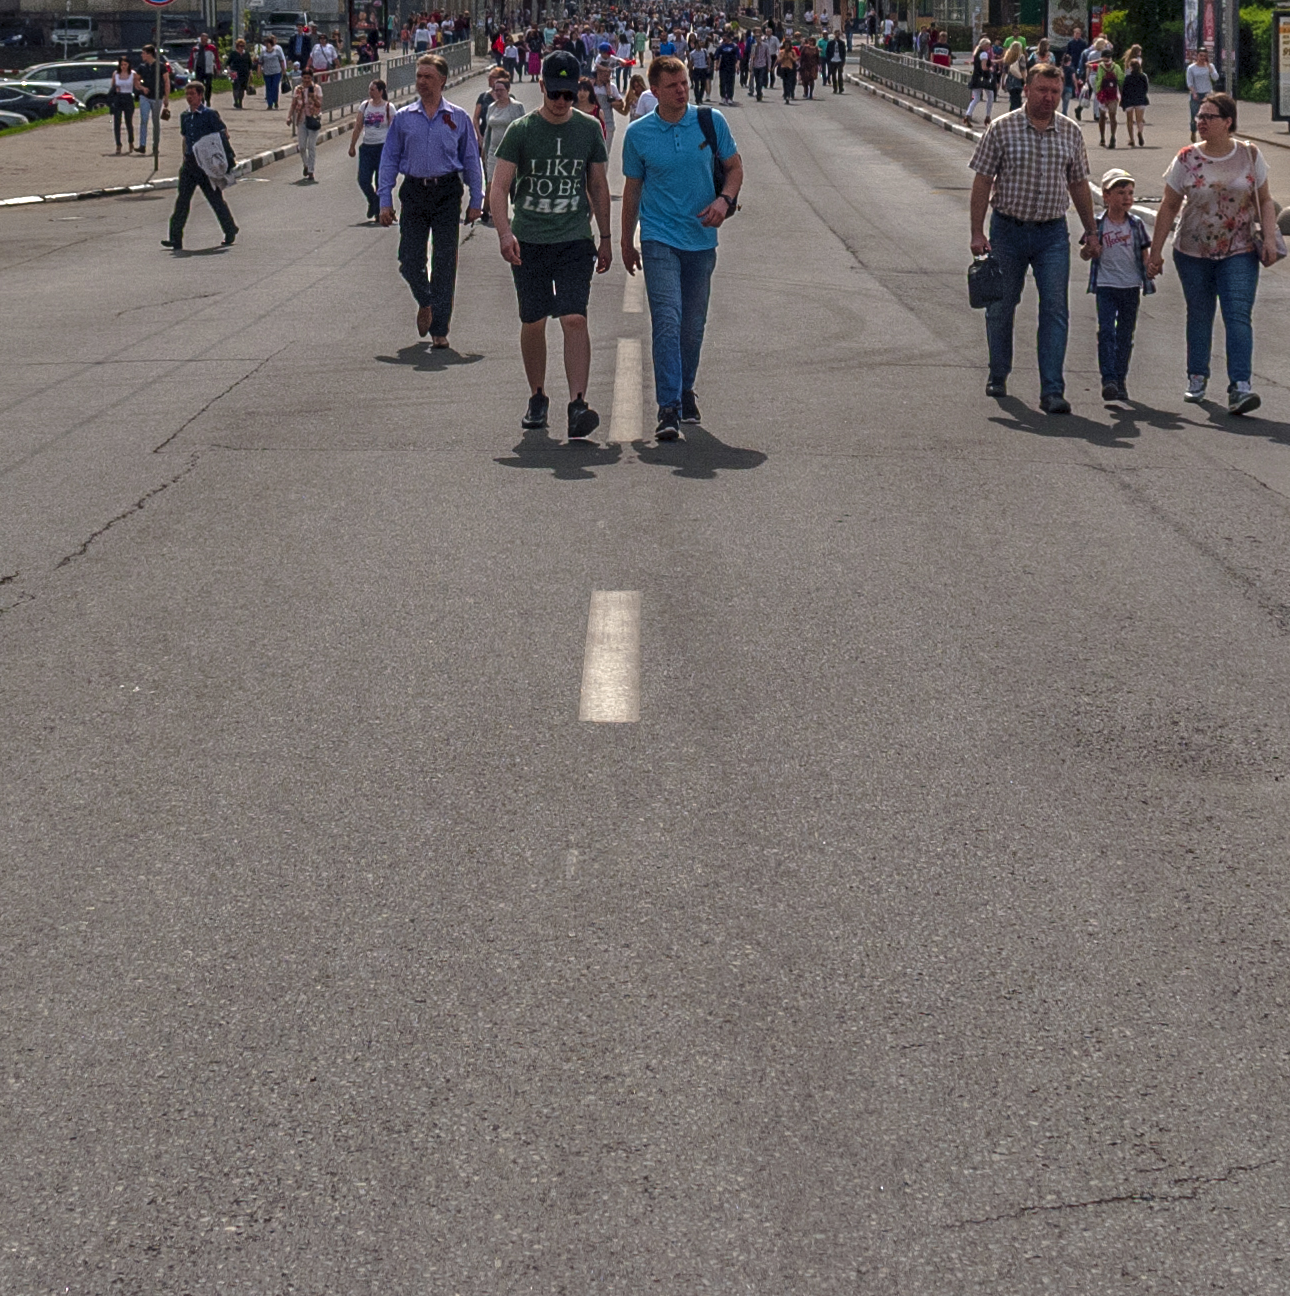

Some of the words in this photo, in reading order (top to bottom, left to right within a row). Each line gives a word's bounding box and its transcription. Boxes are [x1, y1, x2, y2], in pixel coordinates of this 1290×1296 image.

[556, 137, 563, 156] I
[525, 176, 553, 196] TO
[522, 195, 581, 214] LAZY
